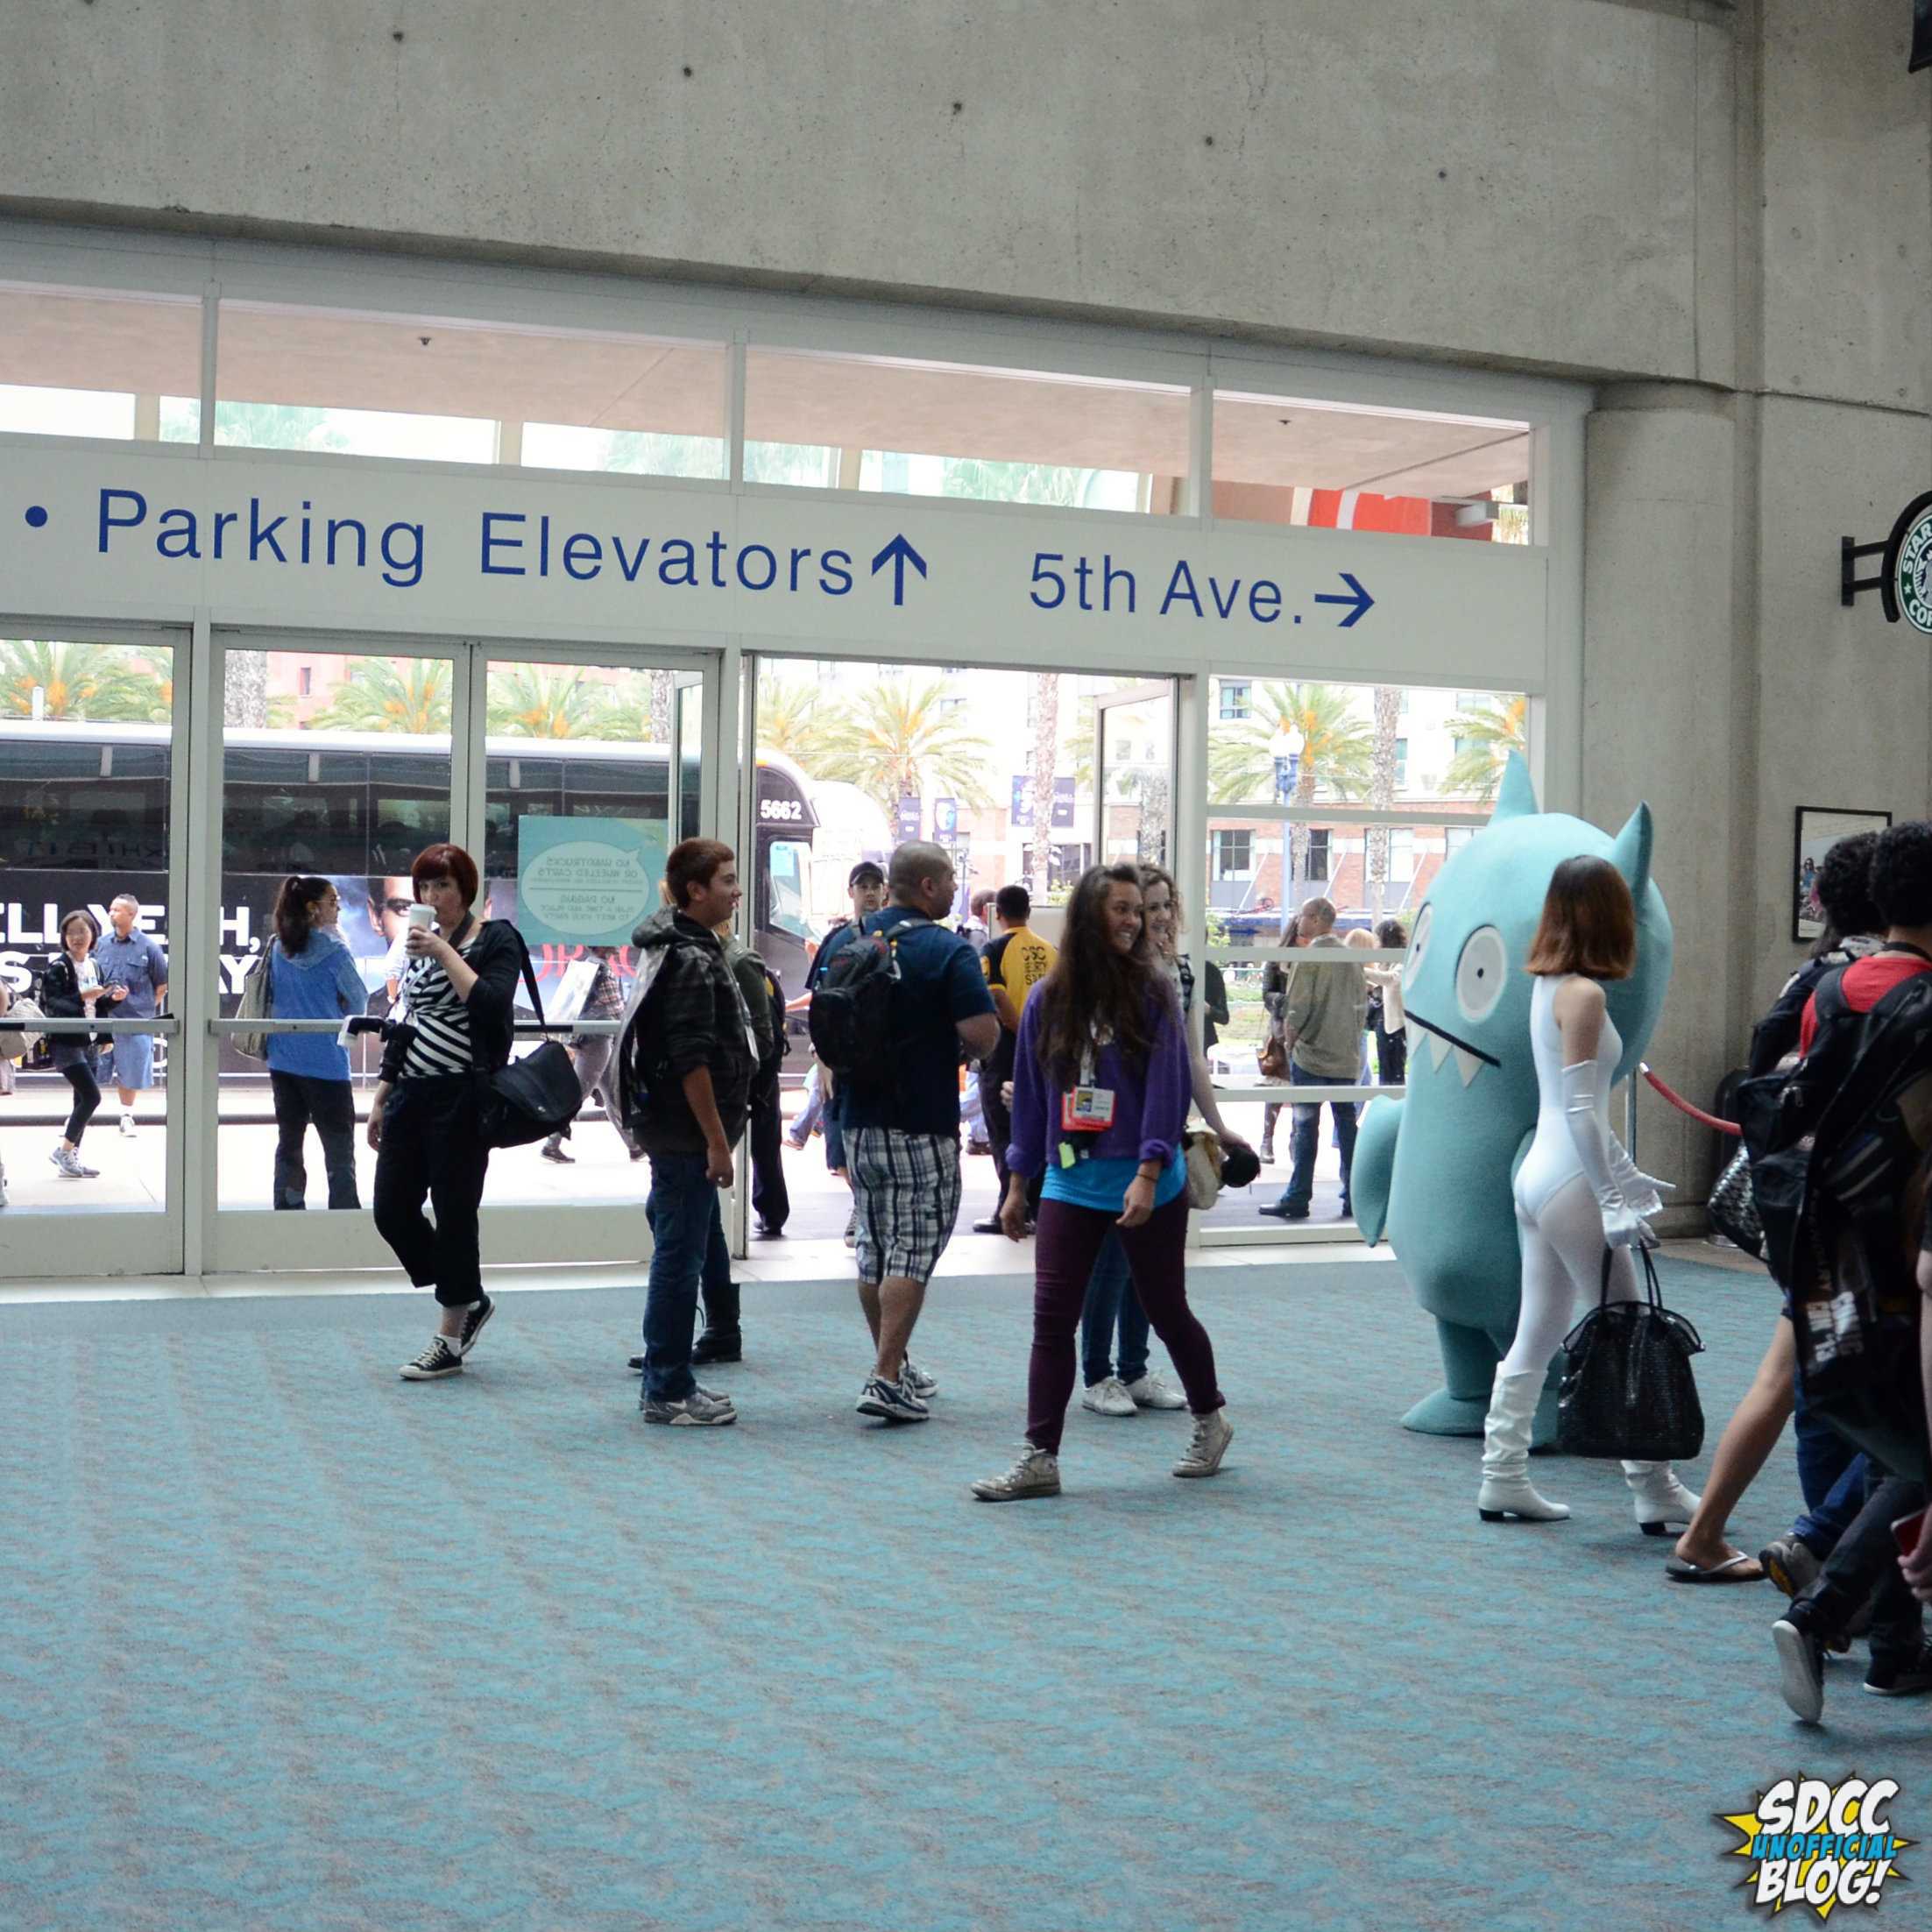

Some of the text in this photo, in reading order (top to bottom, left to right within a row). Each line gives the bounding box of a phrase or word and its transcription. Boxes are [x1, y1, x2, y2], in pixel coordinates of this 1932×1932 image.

[99, 489, 853, 597] Parking Elevators
[1031, 552, 1301, 624] 5th Ave.
[0, 902, 61, 944] LL
